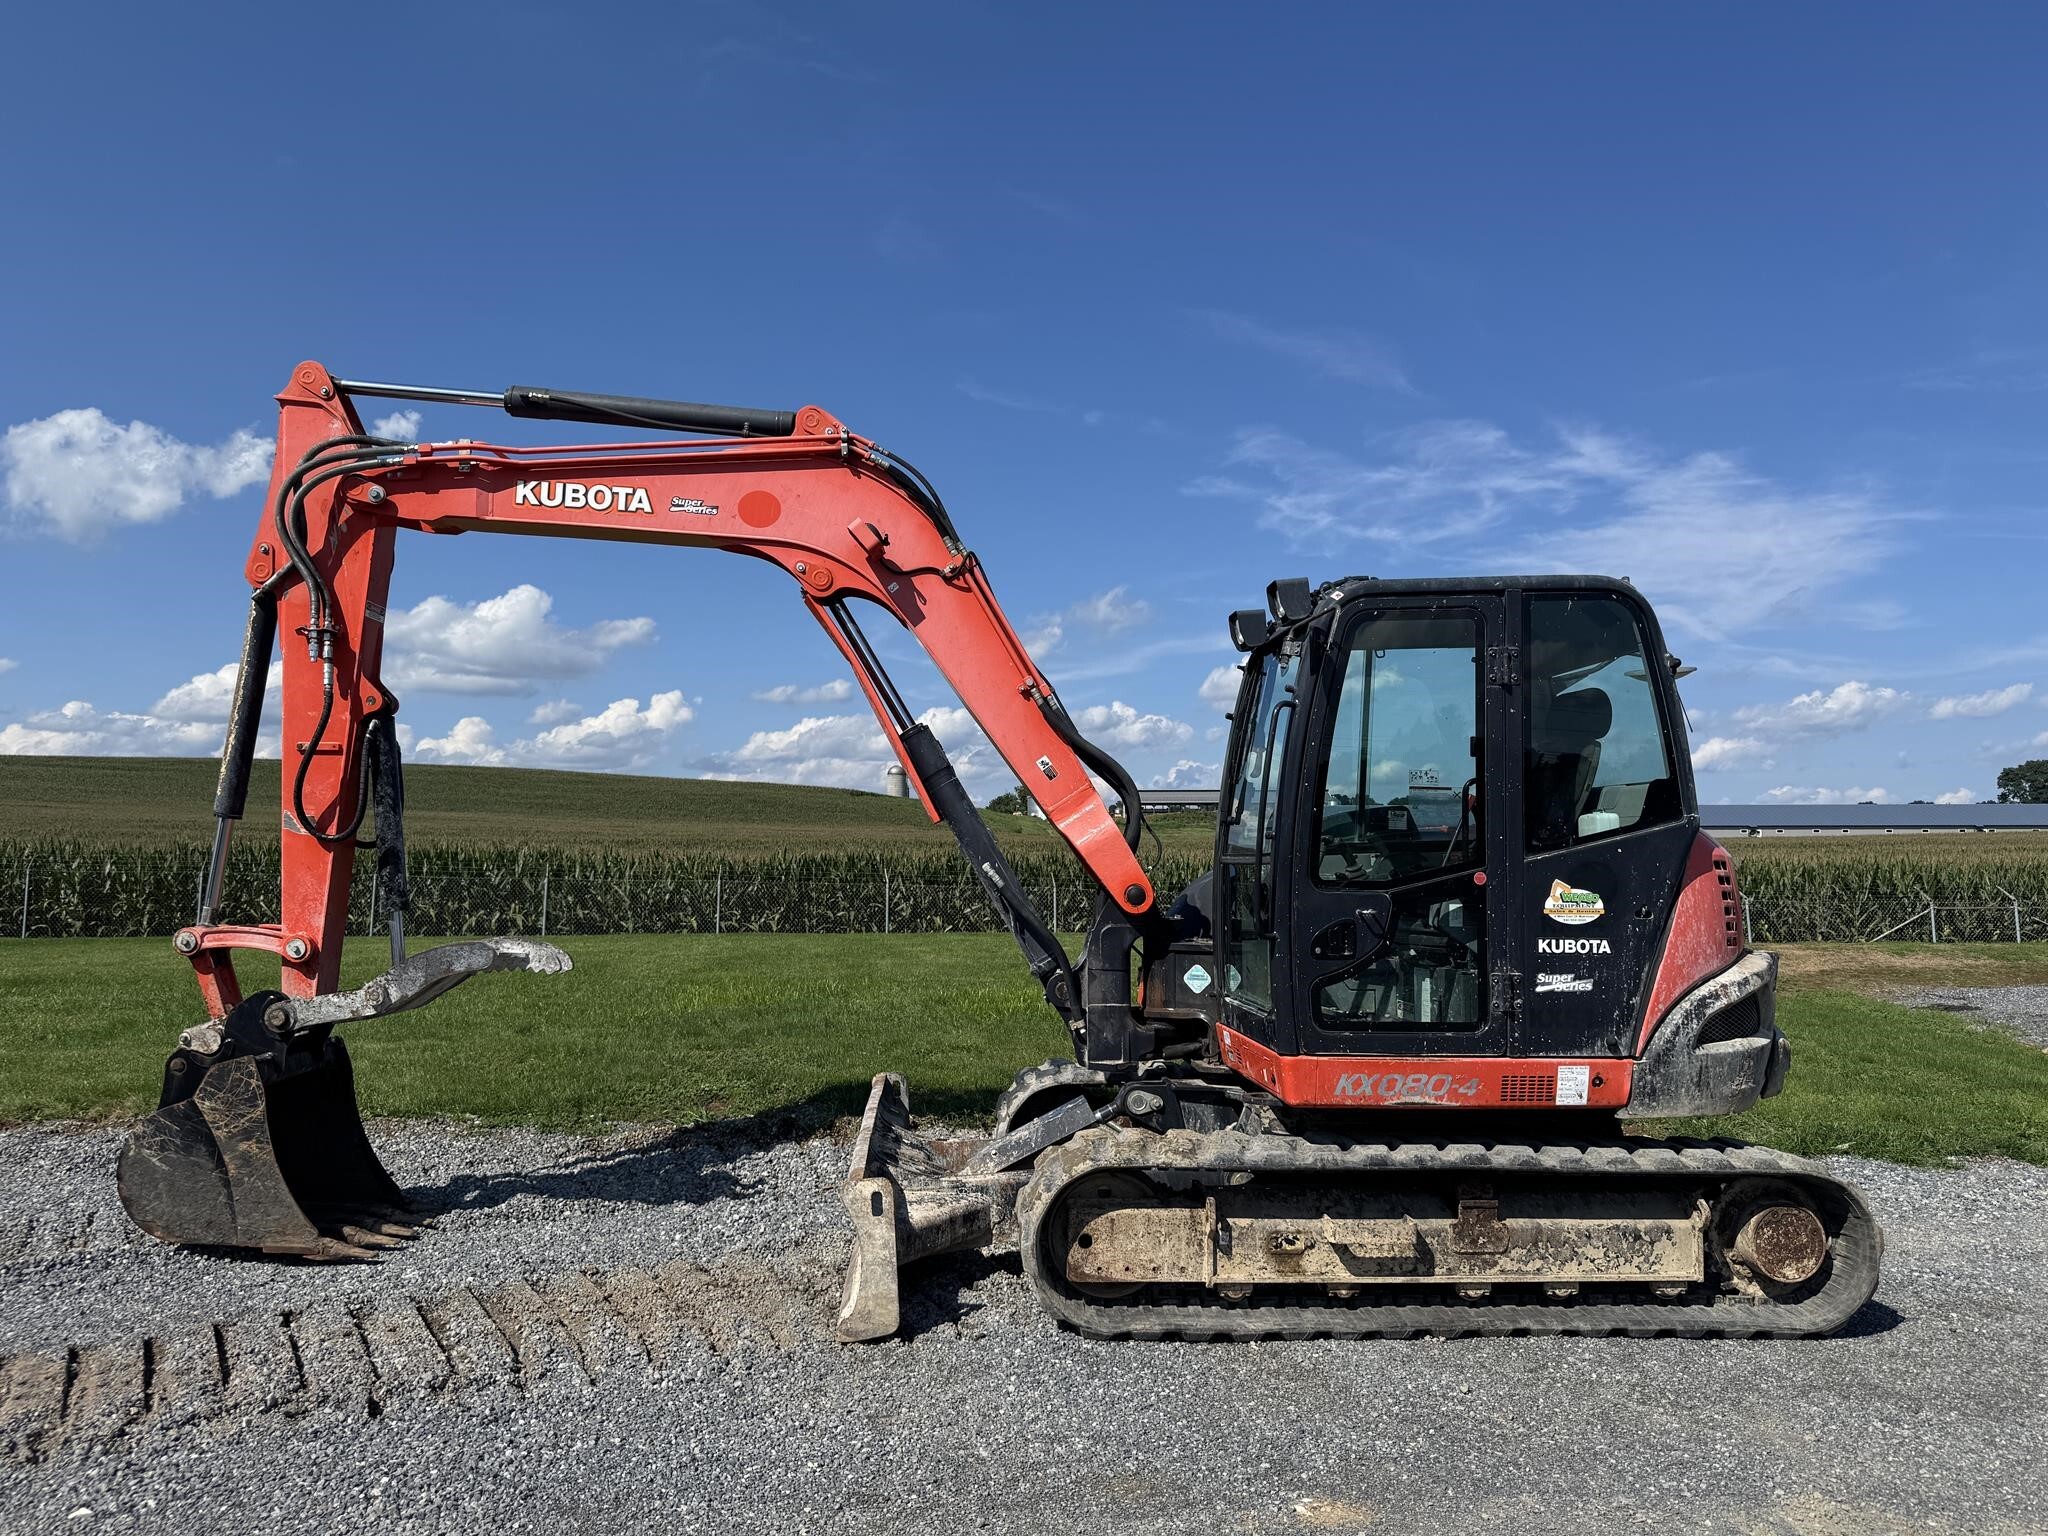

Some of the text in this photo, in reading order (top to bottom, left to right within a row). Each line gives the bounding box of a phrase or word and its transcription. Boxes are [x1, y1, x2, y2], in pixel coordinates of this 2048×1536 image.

[515, 480, 653, 513] KUBOTA
[671, 496, 703, 507] Super
[686, 505, 718, 515] Series
[1538, 939, 1612, 954] KUBOTA
[1536, 973, 1575, 984] Super
[1555, 980, 1594, 992] Series
[1333, 1073, 1479, 1096] KX080-4
